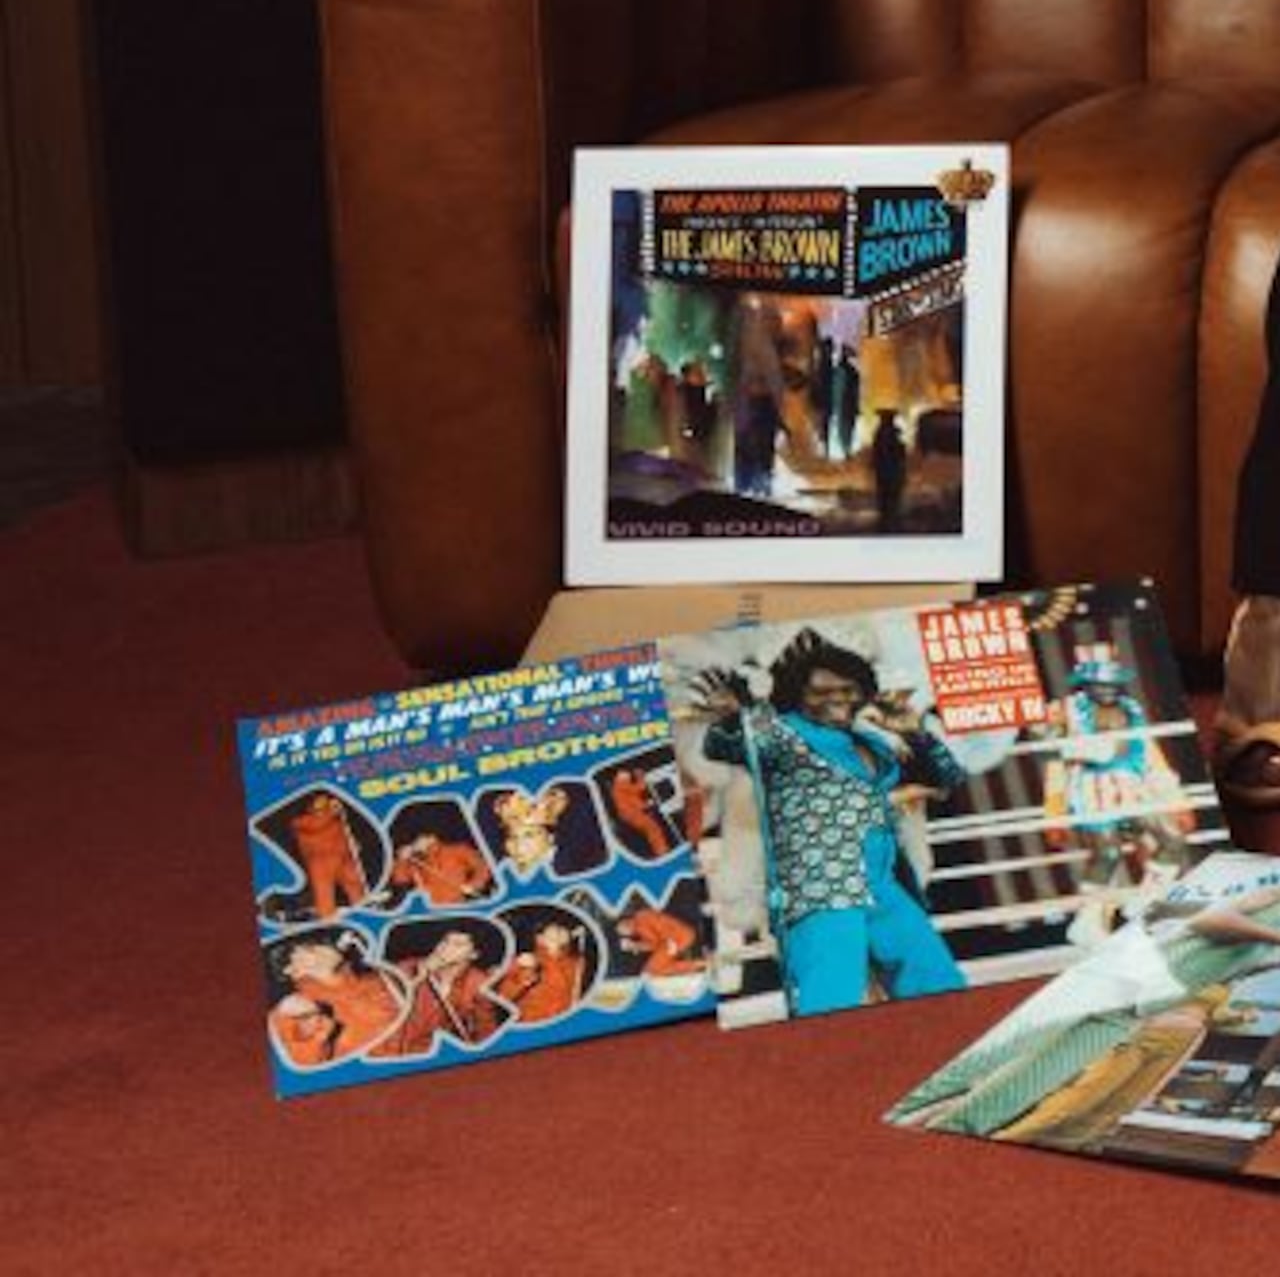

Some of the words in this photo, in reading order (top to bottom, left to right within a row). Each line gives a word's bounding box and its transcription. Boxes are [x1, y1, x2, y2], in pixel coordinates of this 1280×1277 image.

[862, 198, 950, 237] JAMES
[662, 229, 694, 259] THE
[694, 229, 754, 263] JAMES
[758, 229, 841, 267] BROWN
[859, 228, 952, 284] BROWN
[609, 521, 691, 536] VIVID
[702, 520, 820, 536] SOUND
[924, 606, 1024, 641] JAMES
[927, 630, 1028, 663] BROWN
[396, 664, 562, 710] SENSATIONAL
[253, 731, 305, 759] IT'S
[314, 725, 336, 748] A
[344, 706, 432, 741] MAN'S
[438, 687, 523, 721] MAN'S
[533, 671, 617, 703] MAN'S
[359, 765, 470, 800] SOUL
[477, 722, 670, 774] BROTHER
